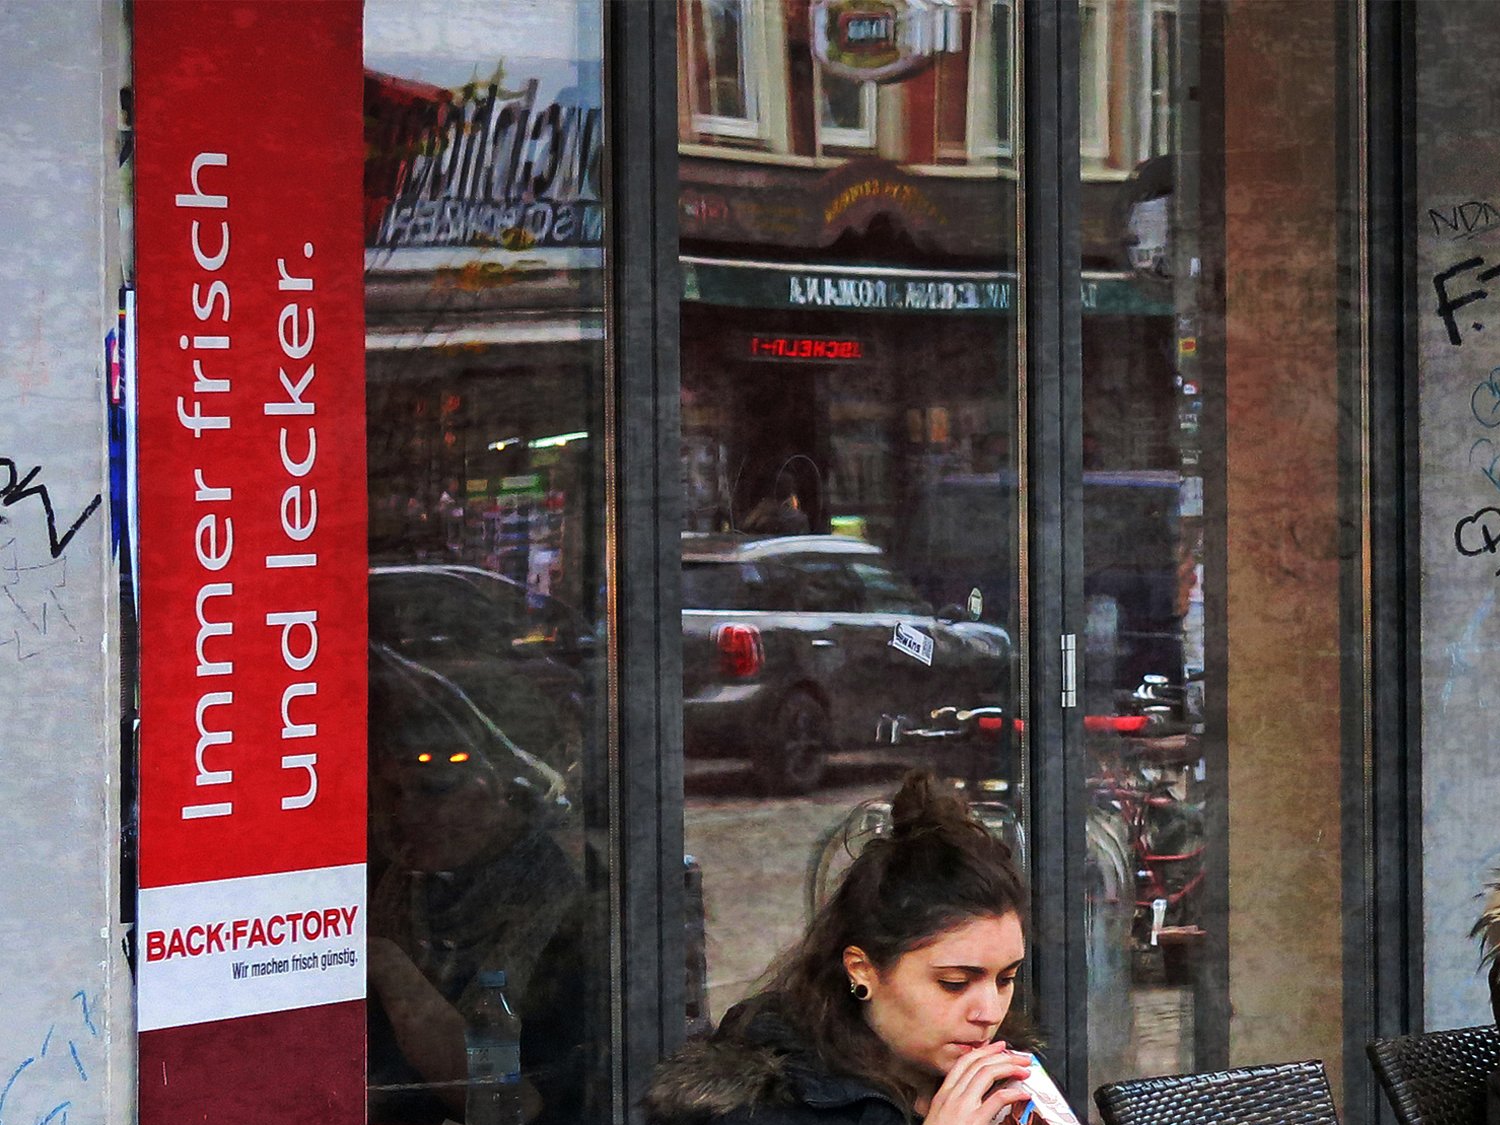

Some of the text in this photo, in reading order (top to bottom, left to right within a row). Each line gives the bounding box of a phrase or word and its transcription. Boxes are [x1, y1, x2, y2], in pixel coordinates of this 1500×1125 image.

[175, 151, 234, 820] Immer frisch
[263, 241, 318, 811] und lecker.
[232, 962, 249, 980] Wir
[250, 958, 289, 978] machen
[291, 953, 319, 973] frisch
